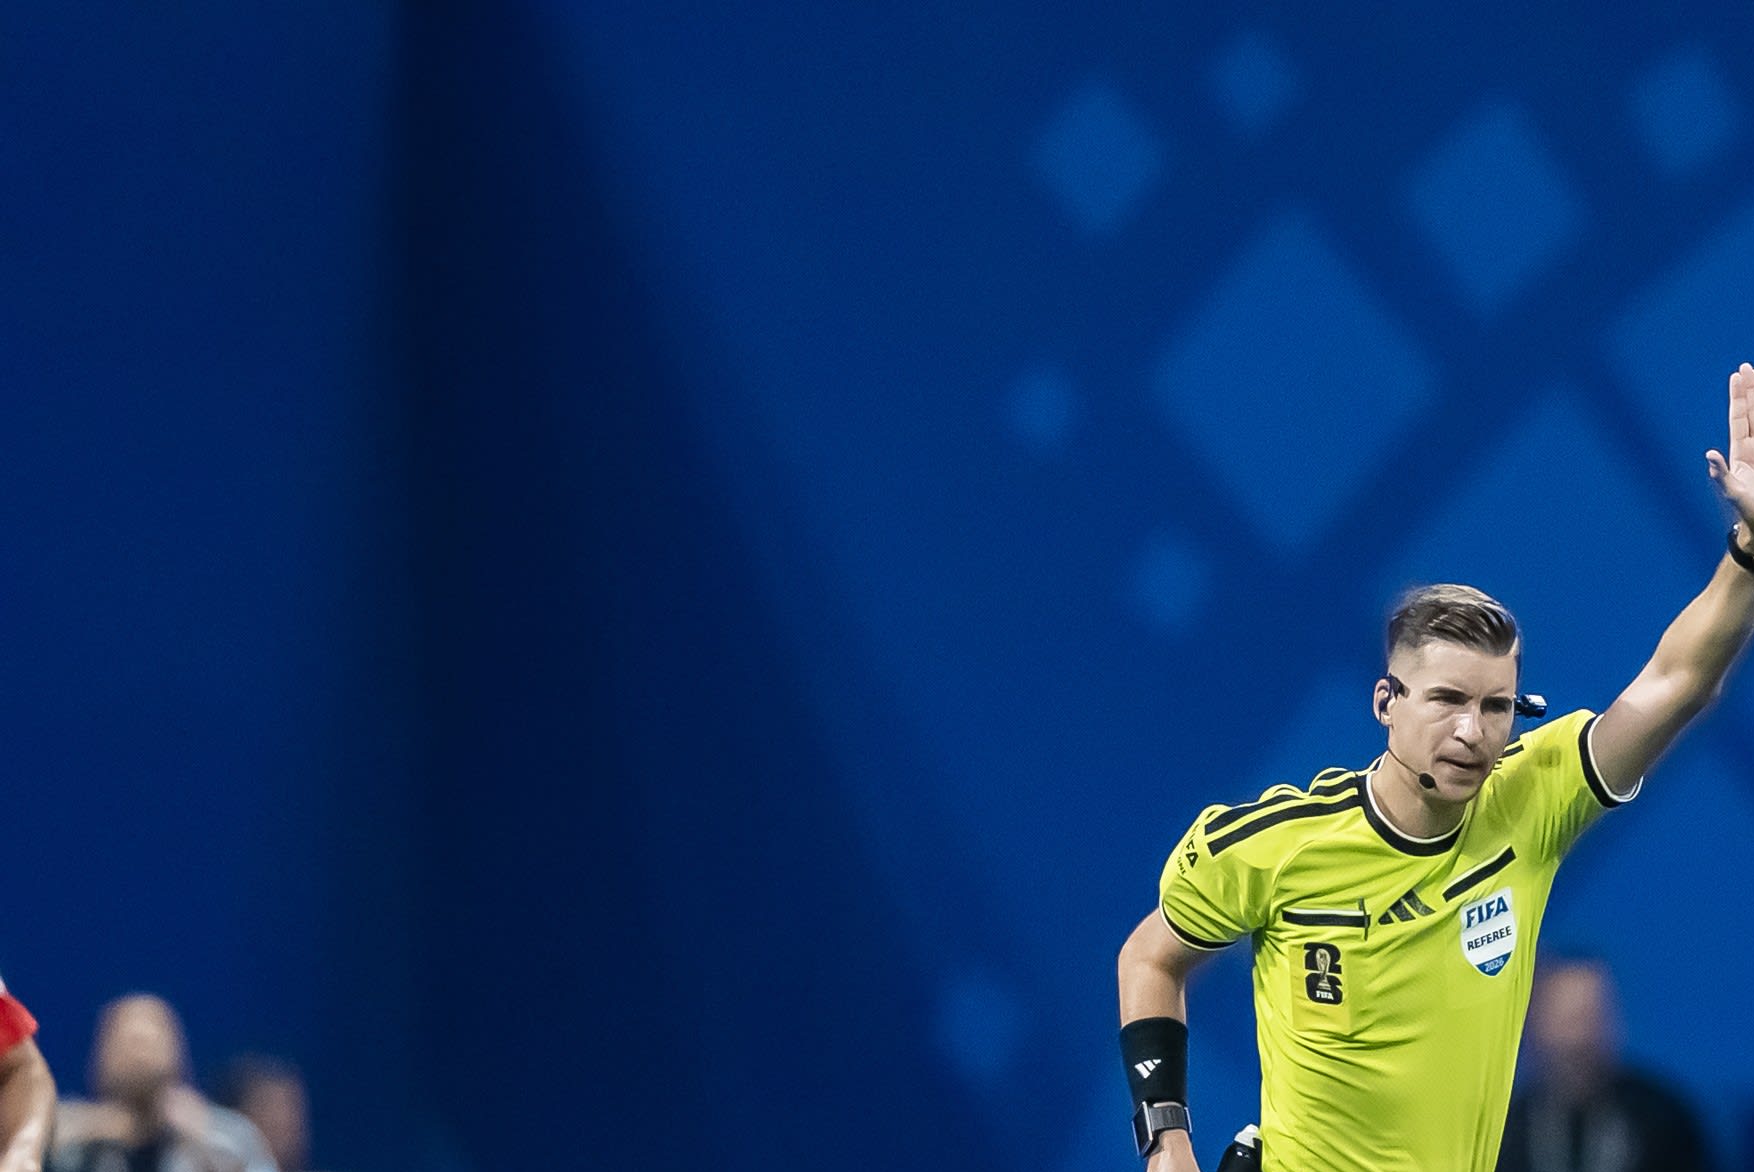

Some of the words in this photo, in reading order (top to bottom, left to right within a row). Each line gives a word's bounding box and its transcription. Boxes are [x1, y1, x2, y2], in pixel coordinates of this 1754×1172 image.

[1466, 896, 1508, 928] FIFA
[1467, 925, 1512, 951] REFEREE
[1485, 957, 1504, 973] 2026
[1315, 990, 1334, 1000] FIFA
